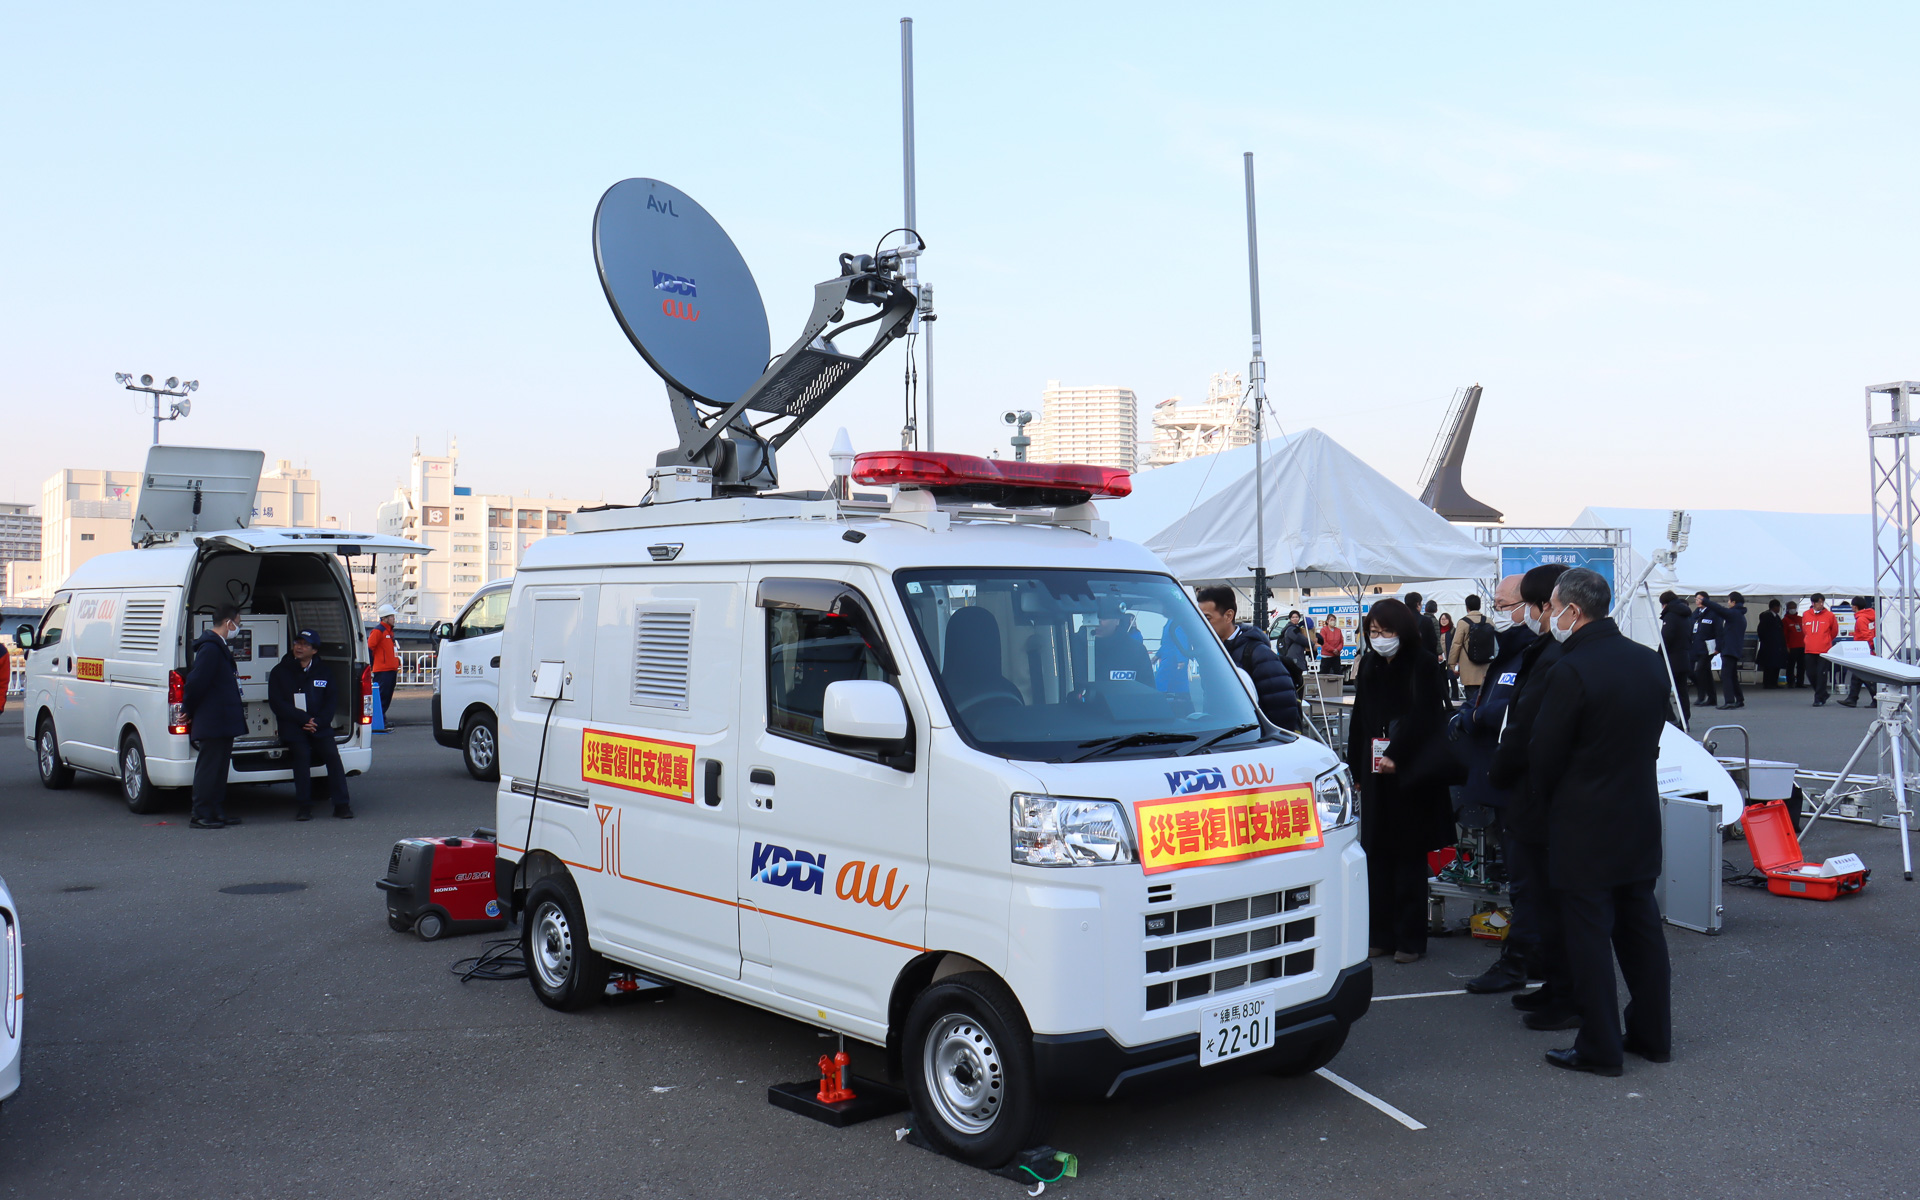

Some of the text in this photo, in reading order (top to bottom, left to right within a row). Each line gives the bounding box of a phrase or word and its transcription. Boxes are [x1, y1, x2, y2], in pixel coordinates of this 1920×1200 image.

[647, 194, 679, 218] AvL
[652, 269, 697, 297] KDDI
[662, 299, 700, 322] au
[1112, 671, 1136, 679] KDDI
[587, 740, 689, 790] 災害復旧支援車
[1164, 762, 1274, 795] KDDI au
[1149, 797, 1312, 858] 災害復旧支援車
[750, 841, 910, 910] KDDI au
[1220, 1000, 1260, 1023] 練馬 830
[1206, 1016, 1269, 1057] そ 22-01
